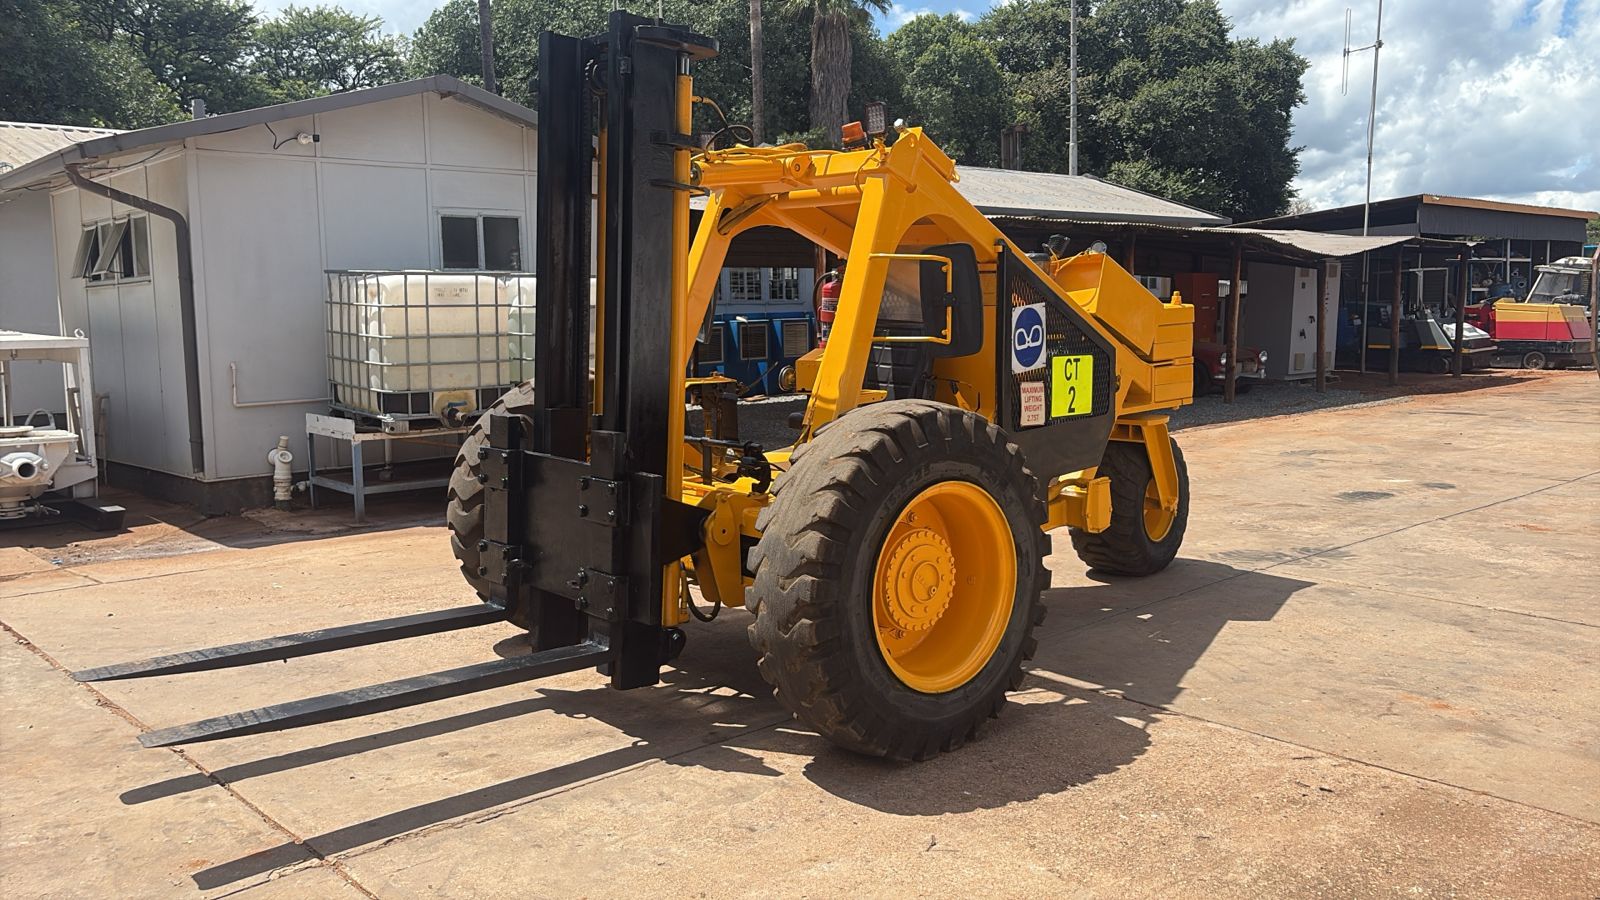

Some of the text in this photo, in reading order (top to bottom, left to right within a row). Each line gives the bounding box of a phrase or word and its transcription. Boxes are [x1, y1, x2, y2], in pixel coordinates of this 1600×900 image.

[1065, 358, 1080, 381] CT
[1022, 386, 1044, 394] MAXIMUM
[1024, 395, 1042, 403] LIFTING
[1068, 386, 1076, 413] 2
[1024, 404, 1042, 412] WEIGHT
